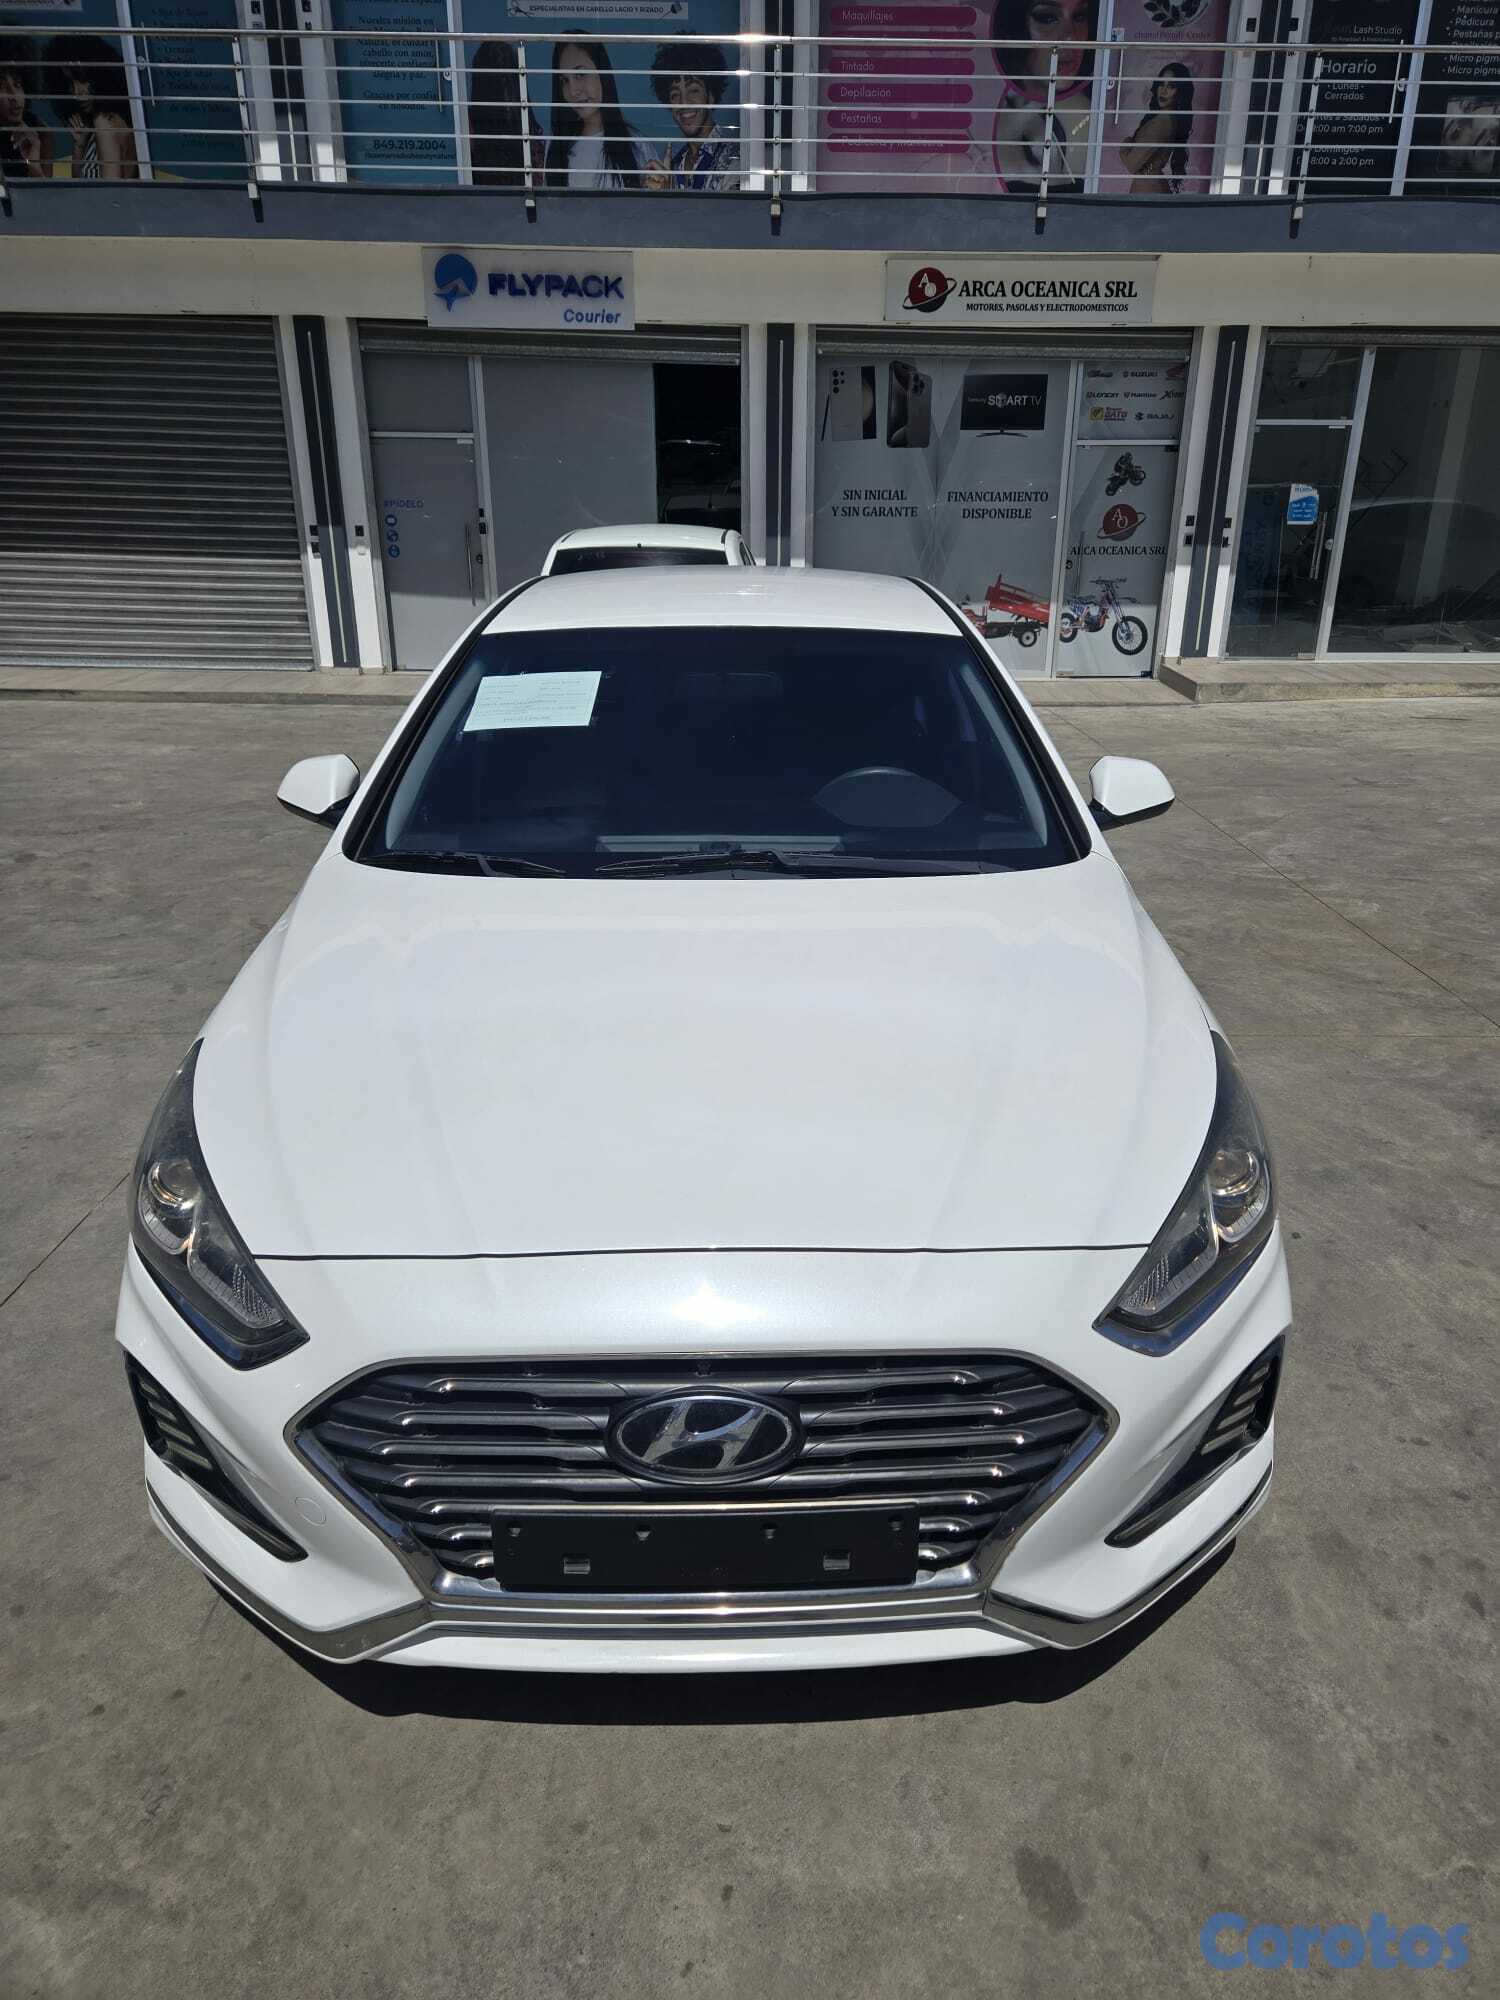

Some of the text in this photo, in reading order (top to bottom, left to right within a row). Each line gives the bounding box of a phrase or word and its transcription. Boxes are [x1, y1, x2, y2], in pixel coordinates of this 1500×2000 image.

[1457, 4, 1498, 14] Manicura
[842, 10, 893, 23] Maquillajes
[1455, 17, 1495, 26] Pedicura
[1353, 25, 1374, 34] Lash
[1375, 25, 1402, 35] Studio
[841, 61, 875, 72] Tintado
[1321, 58, 1377, 75] Horario
[1324, 91, 1364, 101] Cerrados
[1368, 126, 1384, 137] pm
[374, 139, 447, 151] 849.219.2004
[1359, 158, 1375, 169] pm
[487, 272, 625, 300] FLYPACK
[958, 280, 1138, 298] ARCA OCEANICA SRL
[966, 303, 1006, 312] MOTORES,
[1005, 303, 1039, 312] PASOLAS
[1046, 303, 1129, 313] ELECTRODOMESTICOS
[563, 308, 622, 325] Courier
[842, 489, 908, 502] SIN INICIAL
[947, 490, 1049, 504] FINANCIAMIENTO
[831, 505, 919, 518] Y SIN GARANTE
[962, 507, 1033, 521] DISPONIBLE
[1097, 546, 1148, 557] OCEANICA
